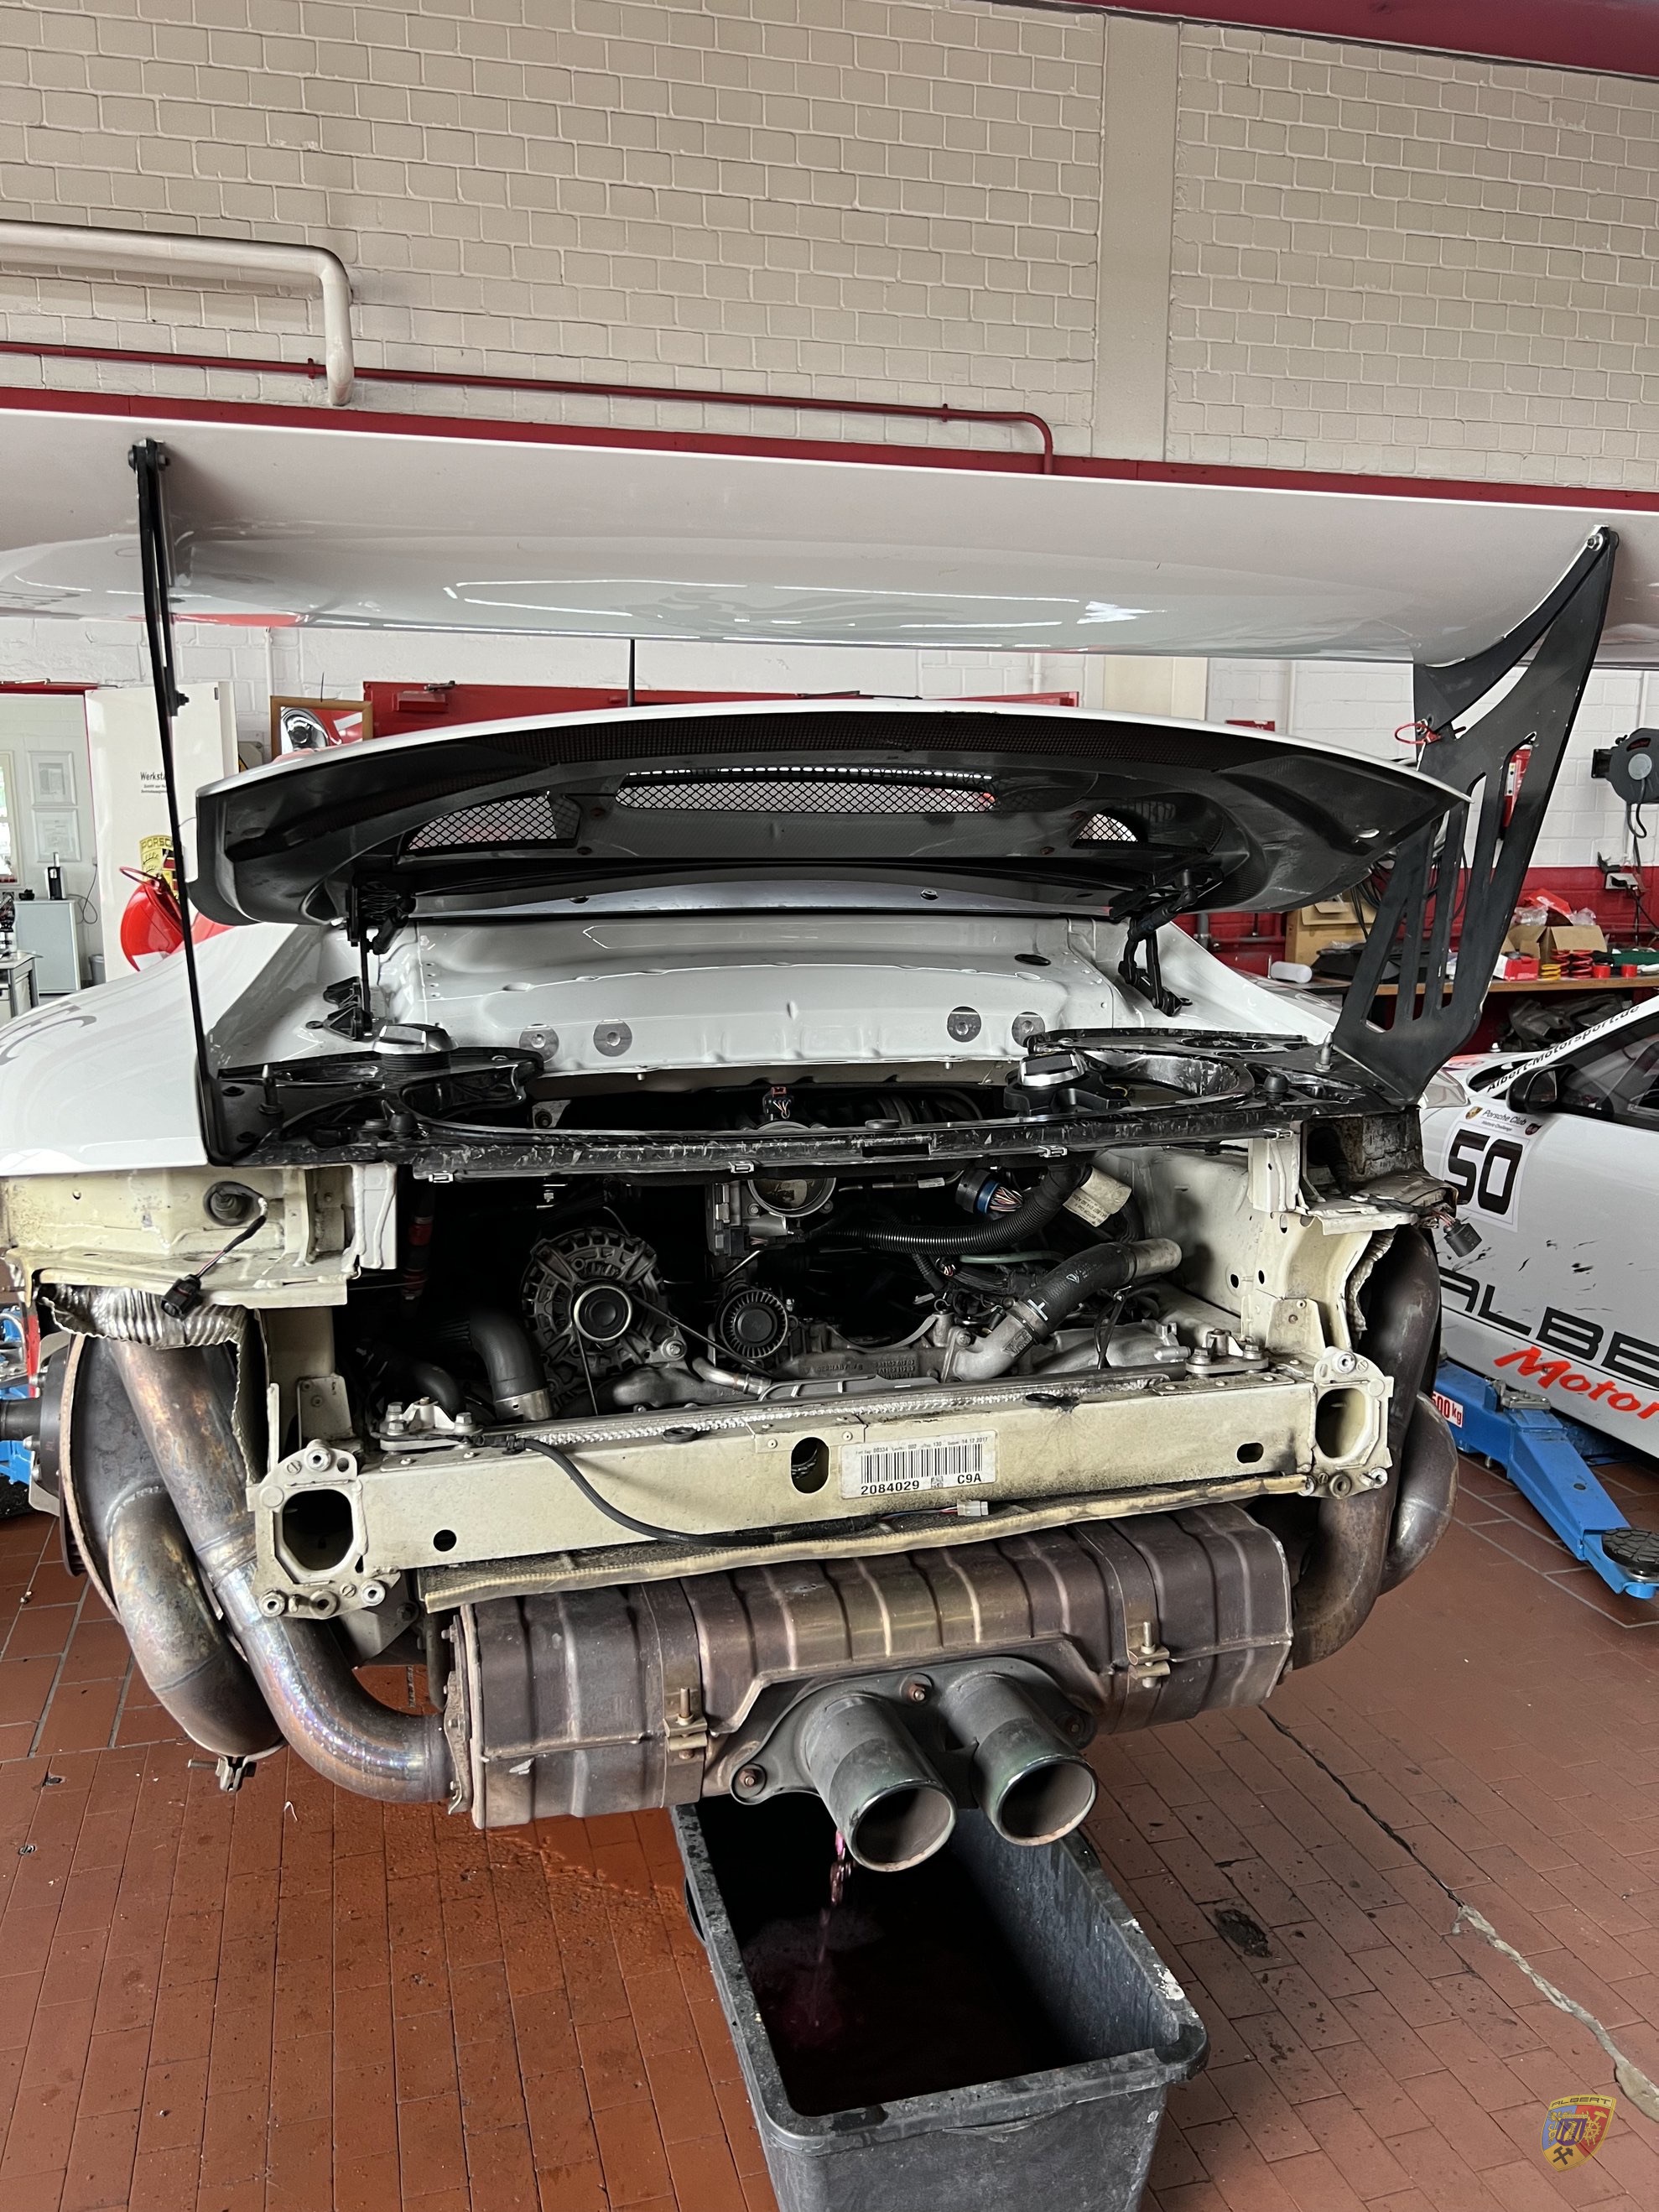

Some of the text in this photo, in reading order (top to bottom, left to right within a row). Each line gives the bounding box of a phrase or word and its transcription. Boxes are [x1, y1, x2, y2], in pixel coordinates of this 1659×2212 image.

[1486, 1004, 1641, 1092] Albert-Motorsport.de
[1482, 1109, 1526, 1126] Porsche Club
[1444, 1128, 1523, 1215] 50
[1452, 1403, 1462, 1425] kg
[861, 1473, 981, 1496] 2084029 C9A
